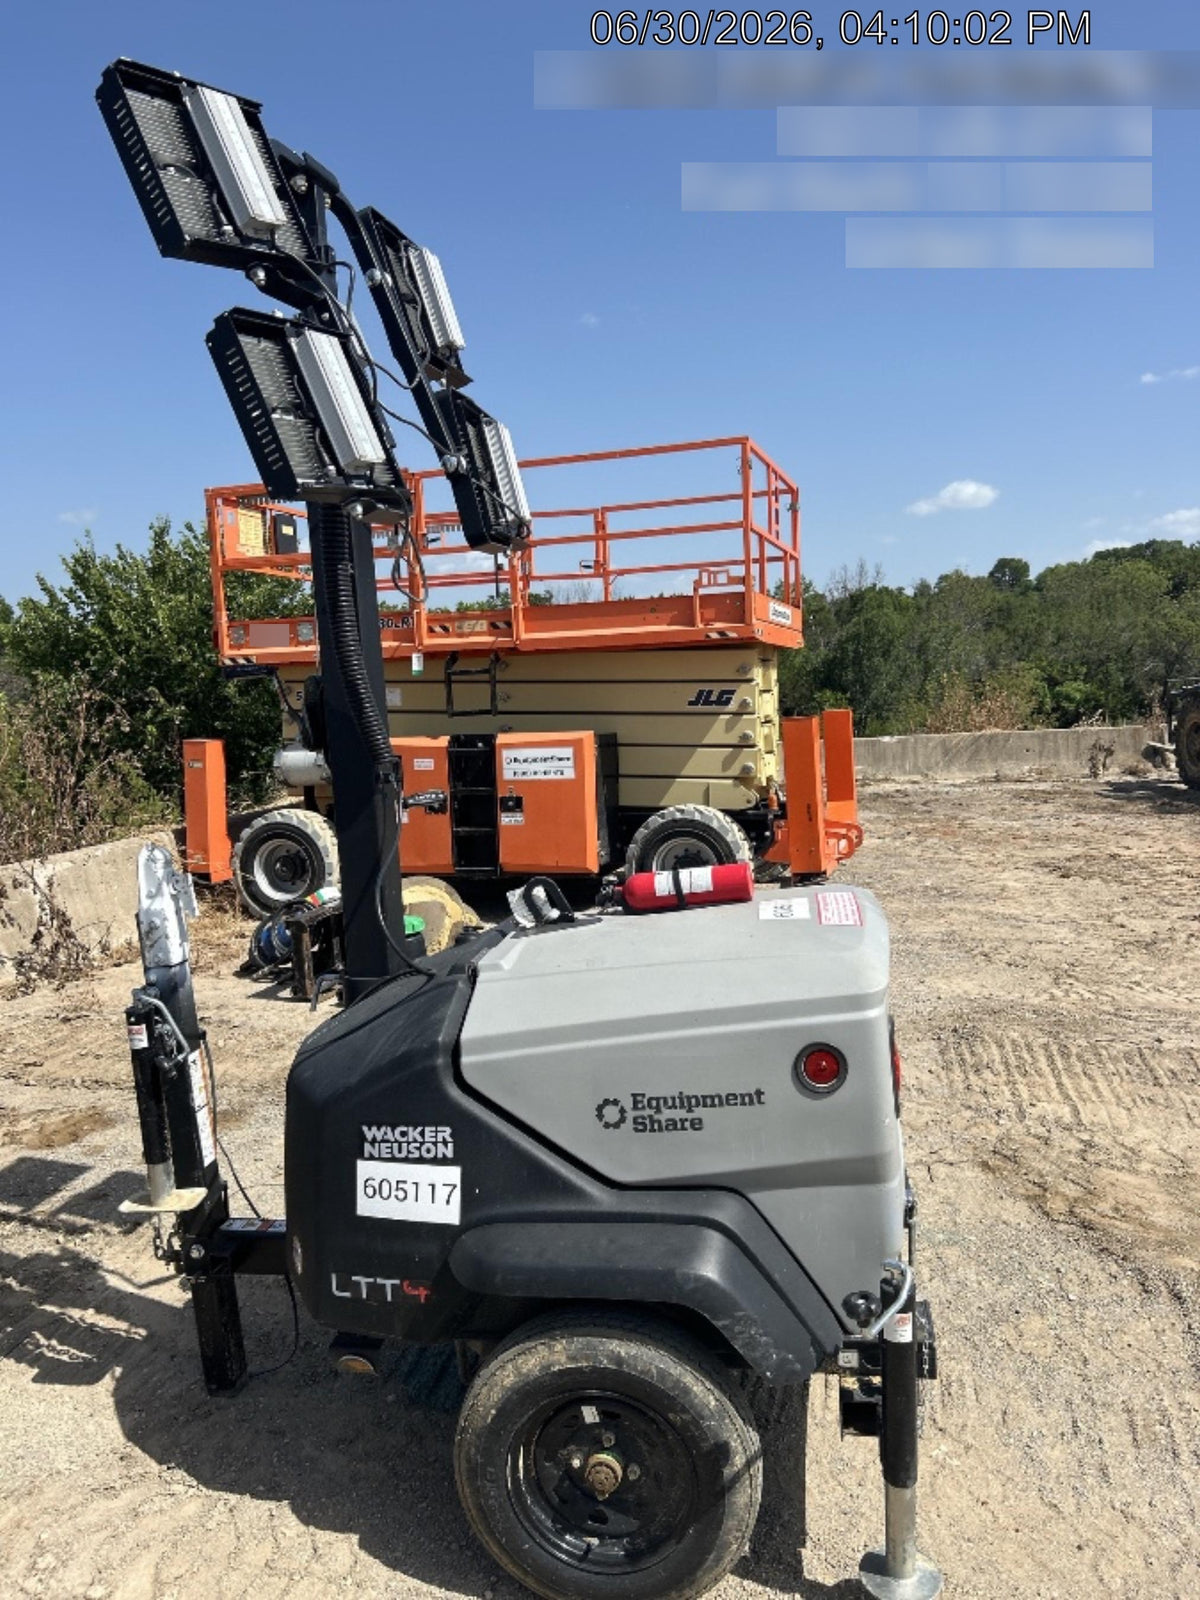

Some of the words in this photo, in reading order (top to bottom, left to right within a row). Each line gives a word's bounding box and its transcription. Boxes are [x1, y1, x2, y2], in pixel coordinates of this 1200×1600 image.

[687, 689, 737, 706] JLG
[630, 1087, 766, 1114] Equipment
[632, 1114, 704, 1133] Share
[362, 1125, 454, 1142] WACKER
[363, 1142, 454, 1158] NEUSON
[363, 1177, 458, 1206] 605117
